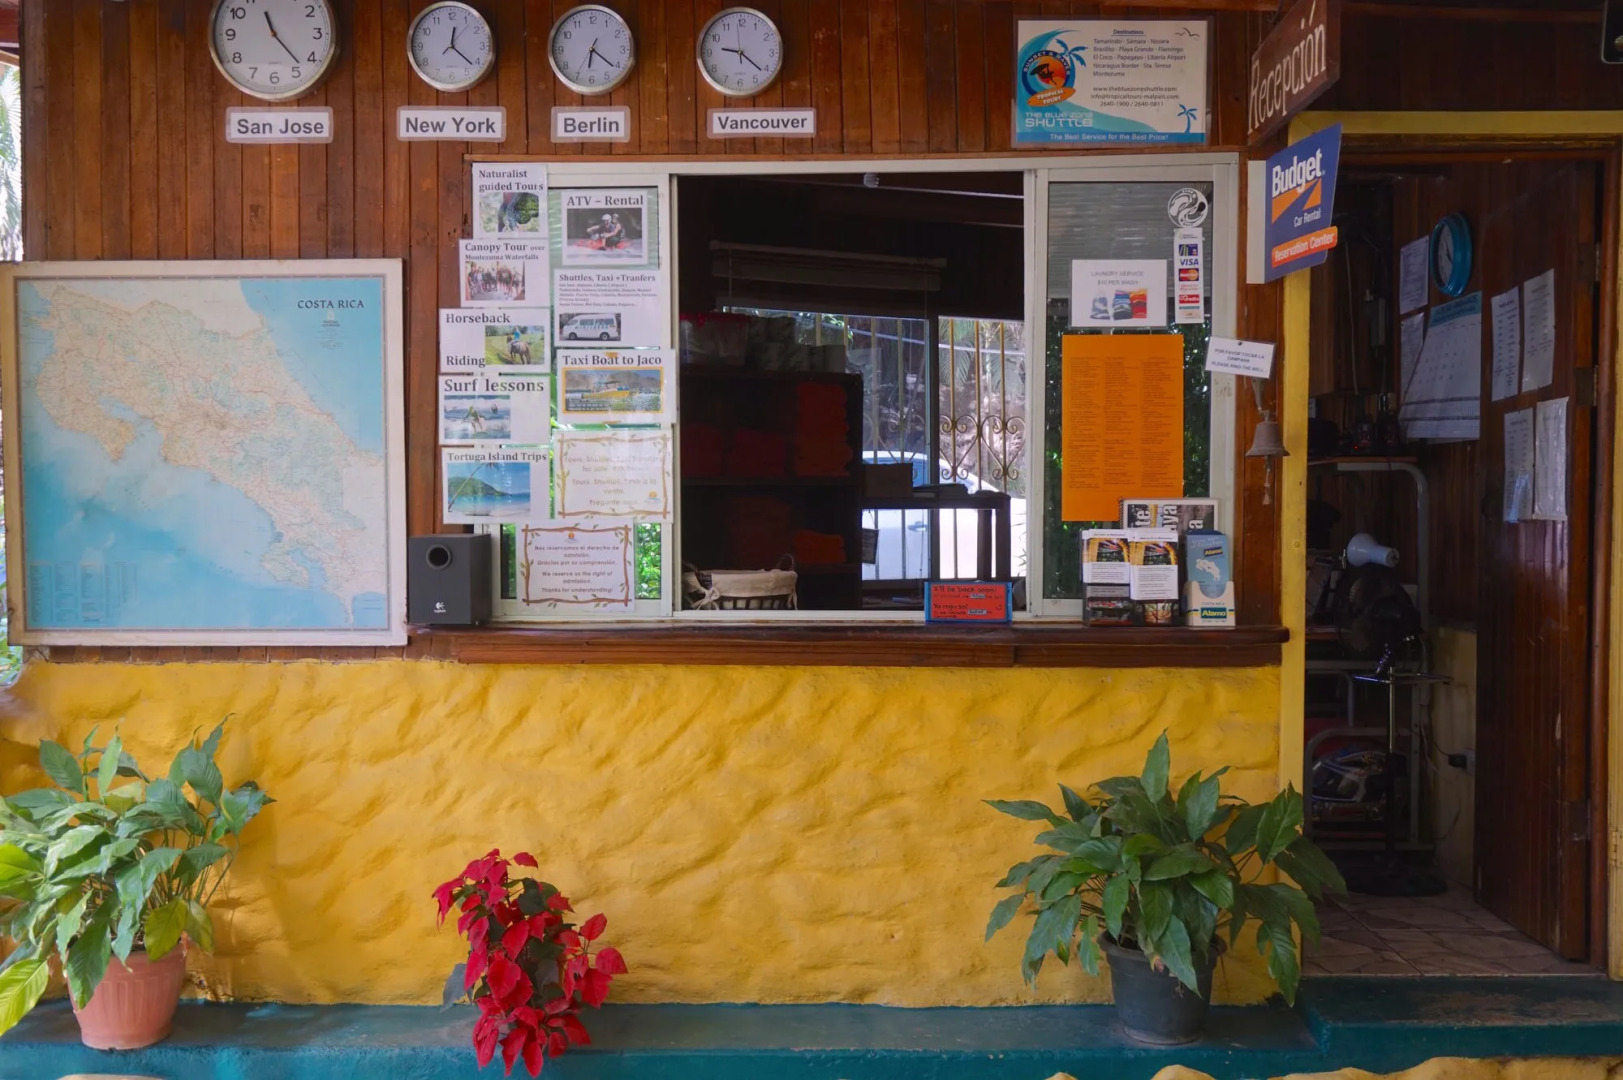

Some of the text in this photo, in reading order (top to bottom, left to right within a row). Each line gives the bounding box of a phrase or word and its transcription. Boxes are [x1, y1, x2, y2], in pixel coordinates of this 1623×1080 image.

[230, 7, 245, 19] 10
[305, 6, 315, 17] 2
[226, 29, 236, 40] 9
[313, 28, 322, 39] 3
[233, 52, 242, 63] 8
[307, 51, 316, 63] 4
[1024, 51, 1046, 72] SUNSET
[292, 67, 301, 78] 5
[1248, 0, 1326, 134] Recepción
[249, 68, 257, 79] 7
[270, 72, 279, 83] 6
[237, 118, 324, 134] San Jose
[406, 117, 496, 133] New York
[564, 118, 619, 133] Berlin
[718, 116, 807, 130] Vancouver
[1025, 118, 1093, 127] SHUTTLE
[479, 169, 528, 178] Naturalist
[1272, 148, 1322, 197] Budget
[479, 182, 512, 193] guided
[567, 195, 644, 206] ATV Rental
[1293, 208, 1321, 228] Car Rental
[465, 243, 501, 254] Canopy
[503, 243, 527, 251] Tour
[1274, 232, 1335, 262] Reservation Center
[1180, 258, 1199, 266] VISA
[559, 274, 594, 282] Shuttles,
[297, 300, 364, 309] COSTA RICA
[446, 313, 510, 323] Horseback
[446, 355, 485, 368] Riding
[562, 355, 662, 367] Taxi Boat to Jaco
[444, 379, 544, 392] Surf lessons
[448, 452, 547, 462] Tortuga Island Trips
